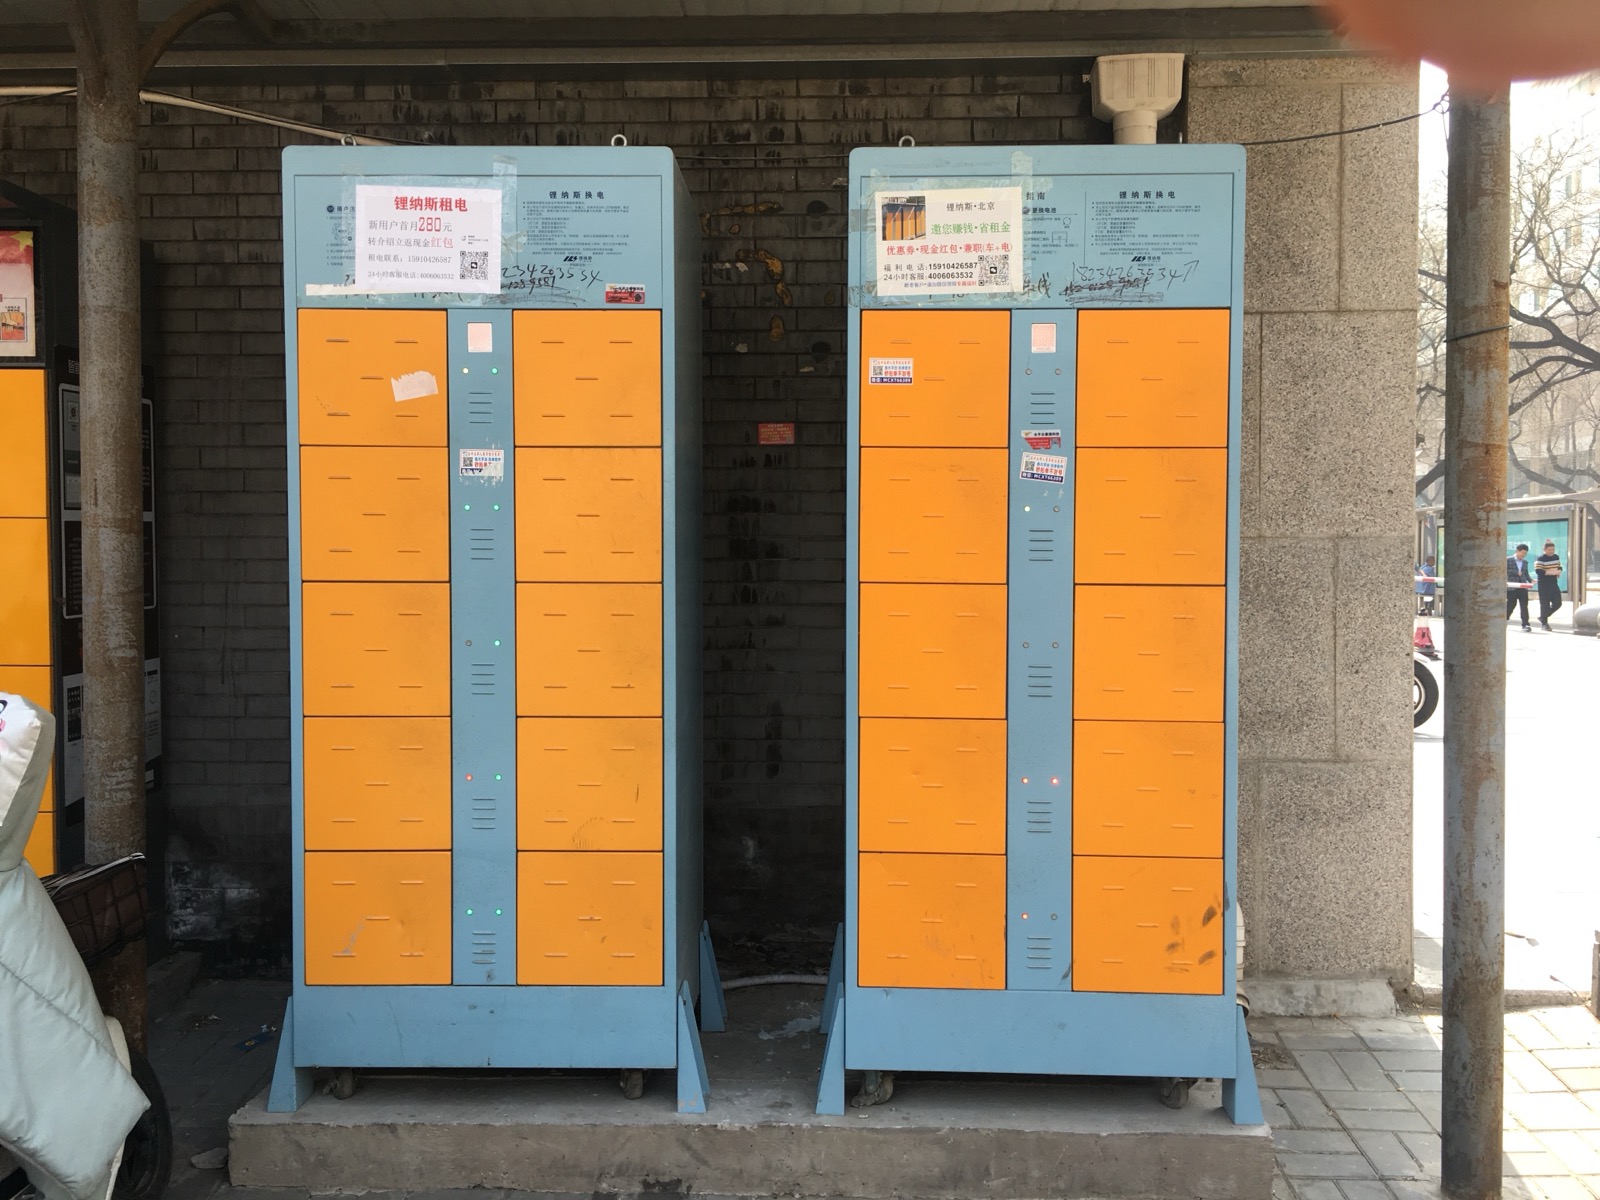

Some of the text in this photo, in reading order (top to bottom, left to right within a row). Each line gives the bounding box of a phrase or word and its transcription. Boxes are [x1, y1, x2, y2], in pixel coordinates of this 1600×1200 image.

[549, 190, 605, 200] 锂纳斯换电
[1119, 190, 1176, 199] 锂纳斯换电
[394, 195, 468, 212] 锂纳斯租电
[946, 201, 995, 212] 锂纳斯·北京
[368, 216, 453, 233] 新用户首月280元
[930, 221, 1011, 235] 邀您赚钱·省租金
[367, 236, 454, 249] 转介绍立返现金红包
